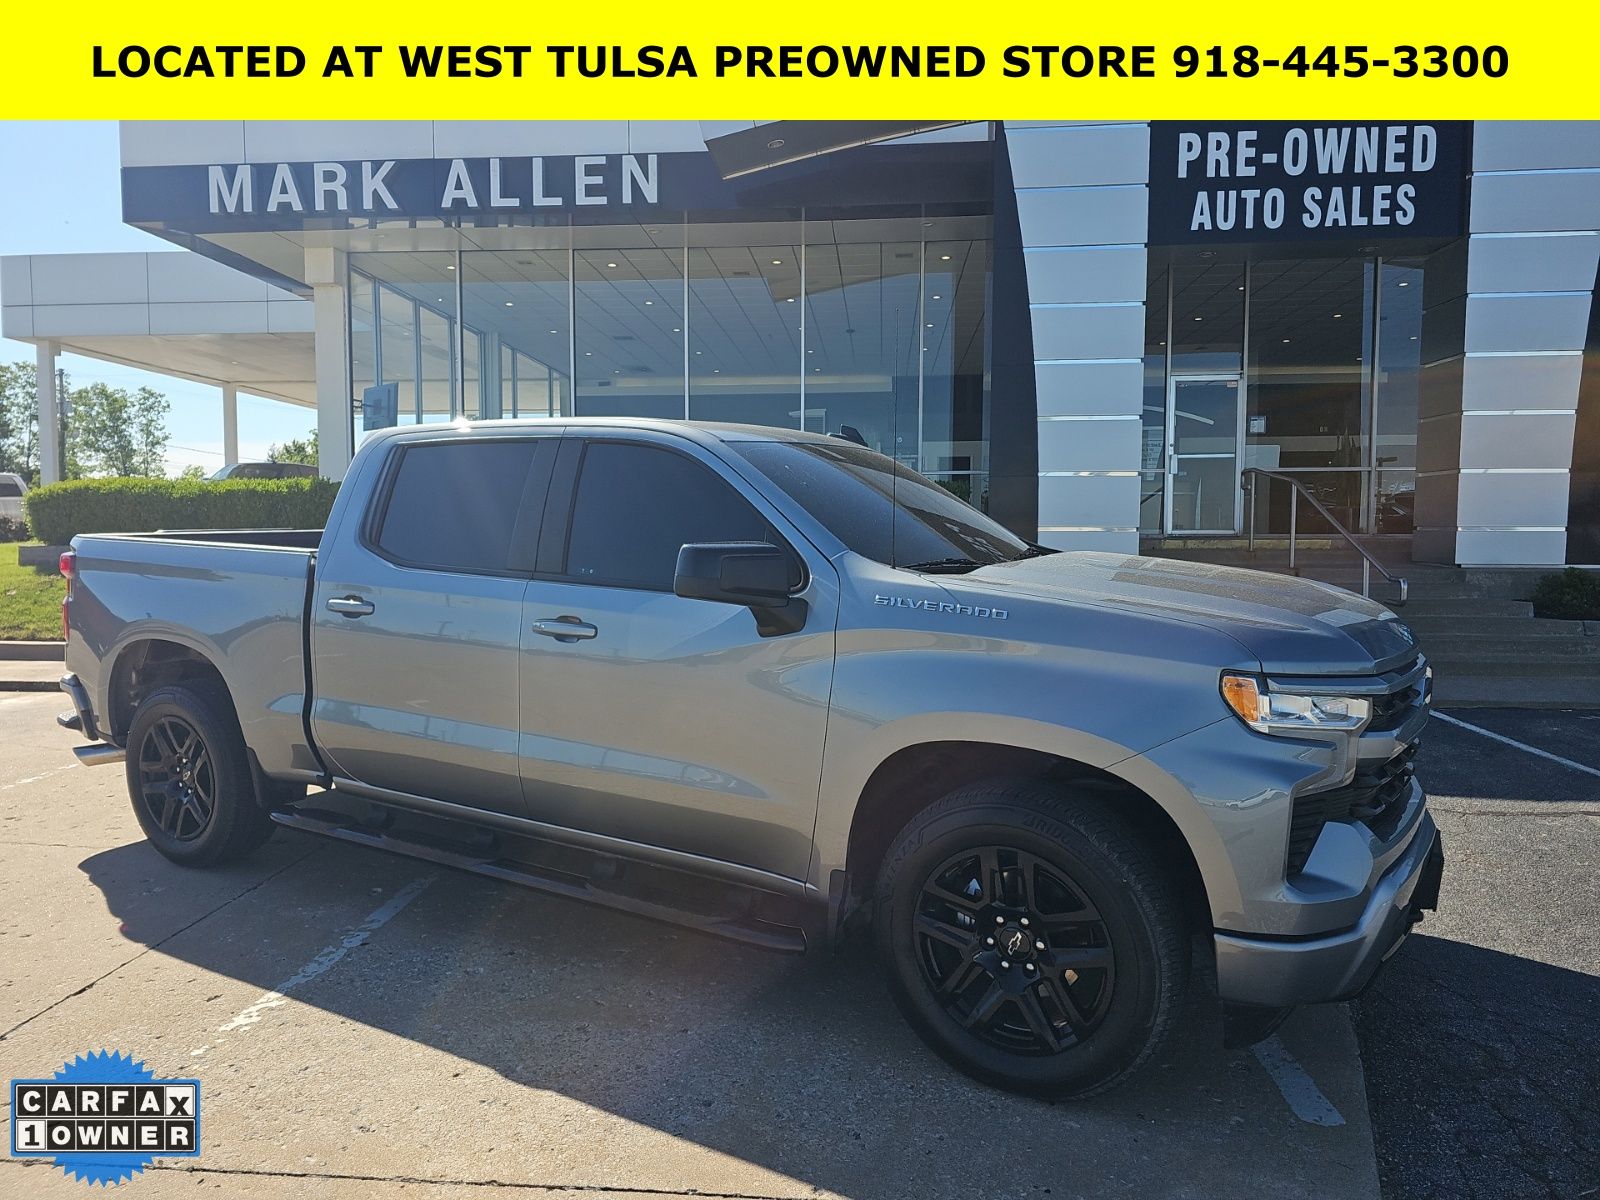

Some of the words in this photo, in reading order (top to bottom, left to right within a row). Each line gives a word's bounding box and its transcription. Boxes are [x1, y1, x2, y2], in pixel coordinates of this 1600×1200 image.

[1177, 125, 1437, 179] PRE-OWNED
[208, 160, 399, 213] MARK
[441, 154, 659, 209] ALLEN
[1190, 187, 1285, 231] AUTO
[1302, 183, 1416, 228] SALES
[874, 594, 1009, 620] SILVERADO
